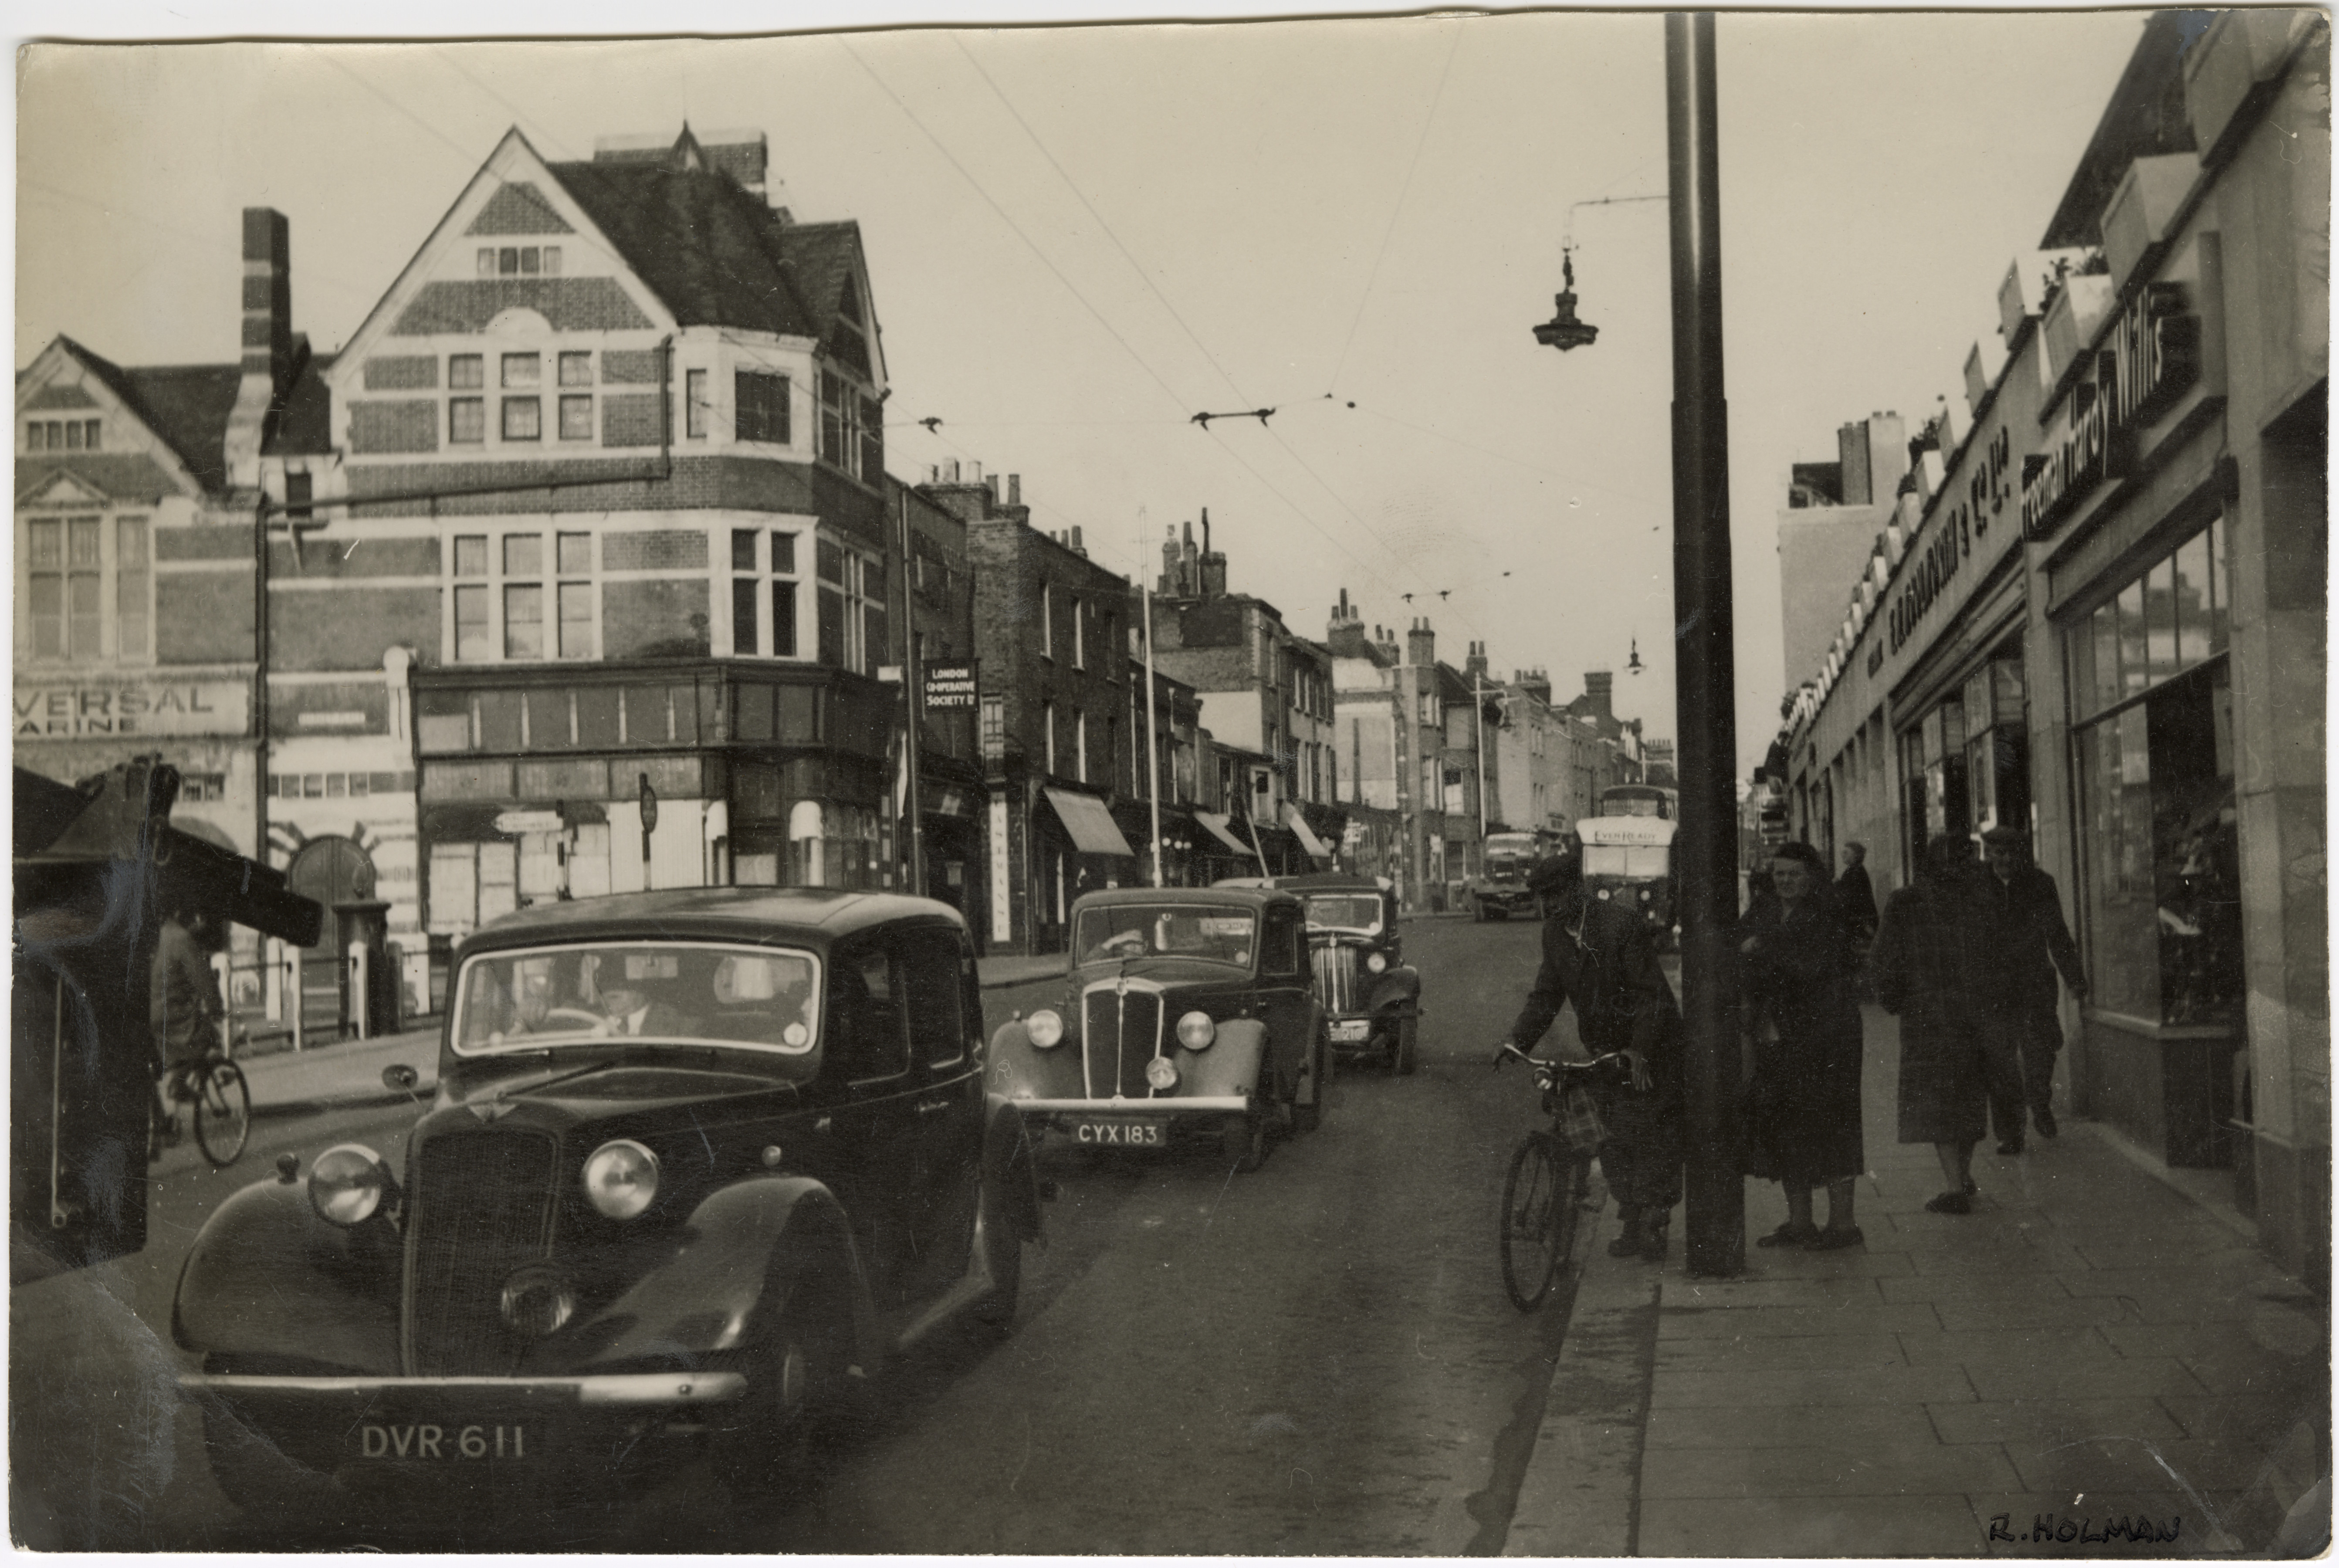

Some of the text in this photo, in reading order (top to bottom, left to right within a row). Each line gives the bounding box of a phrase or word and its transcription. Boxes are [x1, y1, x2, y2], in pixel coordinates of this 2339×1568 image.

[2068, 351, 2110, 485] Hardy
[2115, 286, 2163, 427] Willis
[932, 669, 968, 680] LONDON
[926, 681, 975, 692] CO-OPERATIVE
[927, 695, 965, 706] SOCIETY
[1079, 1124, 1157, 1143] CYX 183
